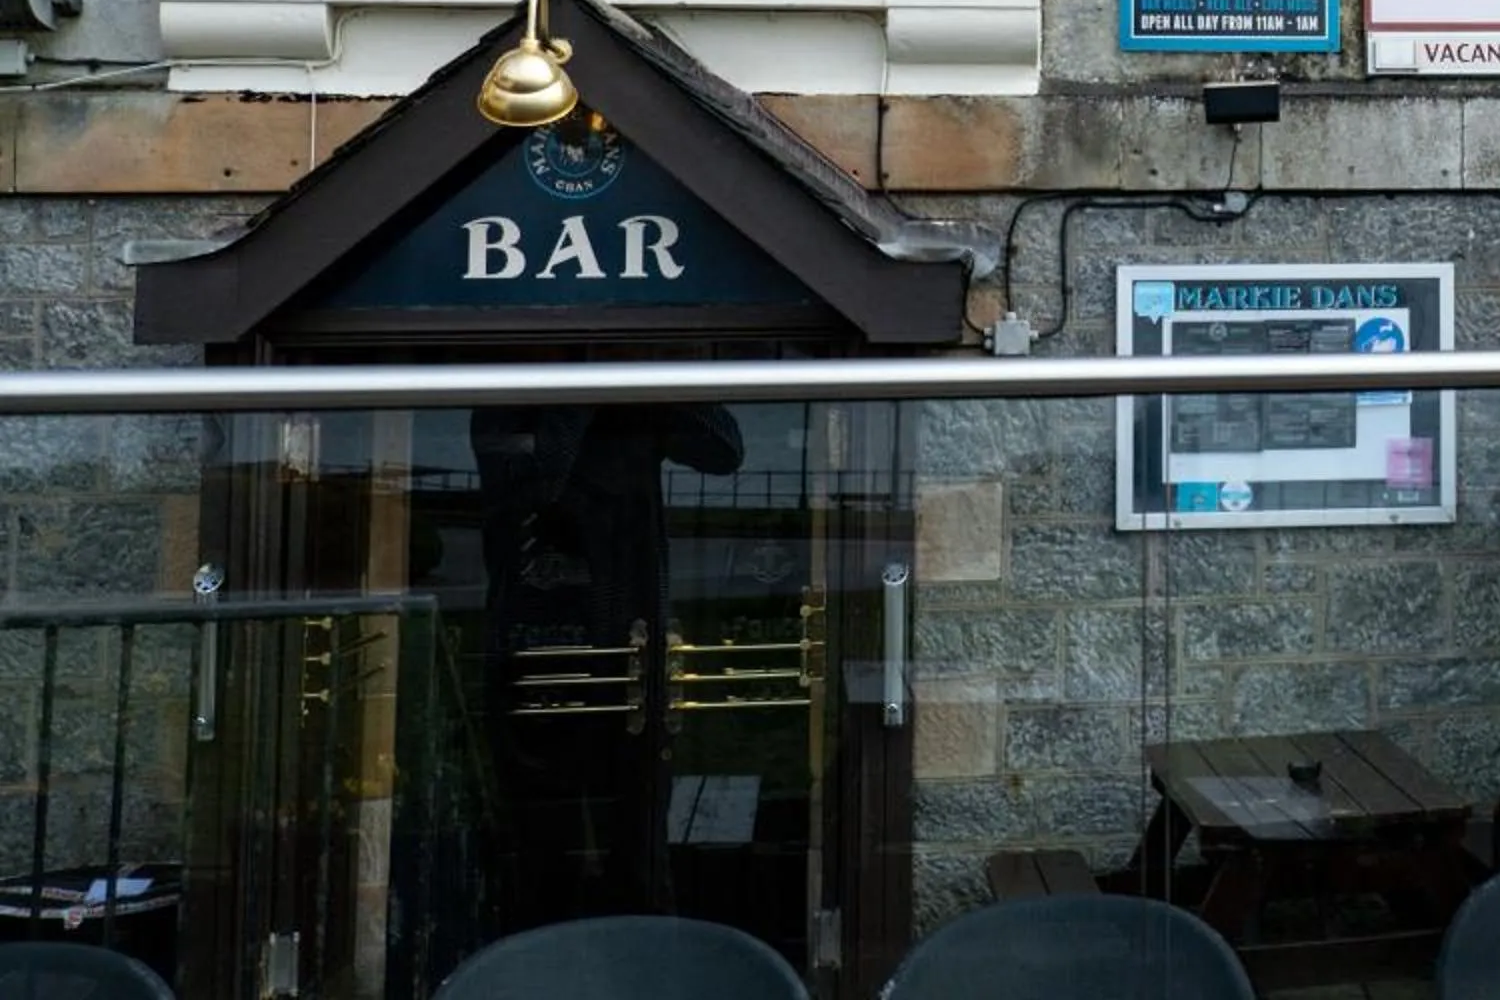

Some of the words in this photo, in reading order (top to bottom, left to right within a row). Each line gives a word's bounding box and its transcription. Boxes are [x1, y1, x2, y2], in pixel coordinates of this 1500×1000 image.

[1141, 14, 1172, 31] OPEN
[1174, 14, 1193, 31] ALL
[1197, 14, 1219, 31] DAY
[1221, 14, 1253, 31] FROM
[1256, 14, 1284, 31] 11AM
[1297, 15, 1319, 31] 1AM
[461, 215, 685, 279] BAR
[1178, 285, 1301, 309] MARKIE
[1311, 284, 1397, 308] DANS
